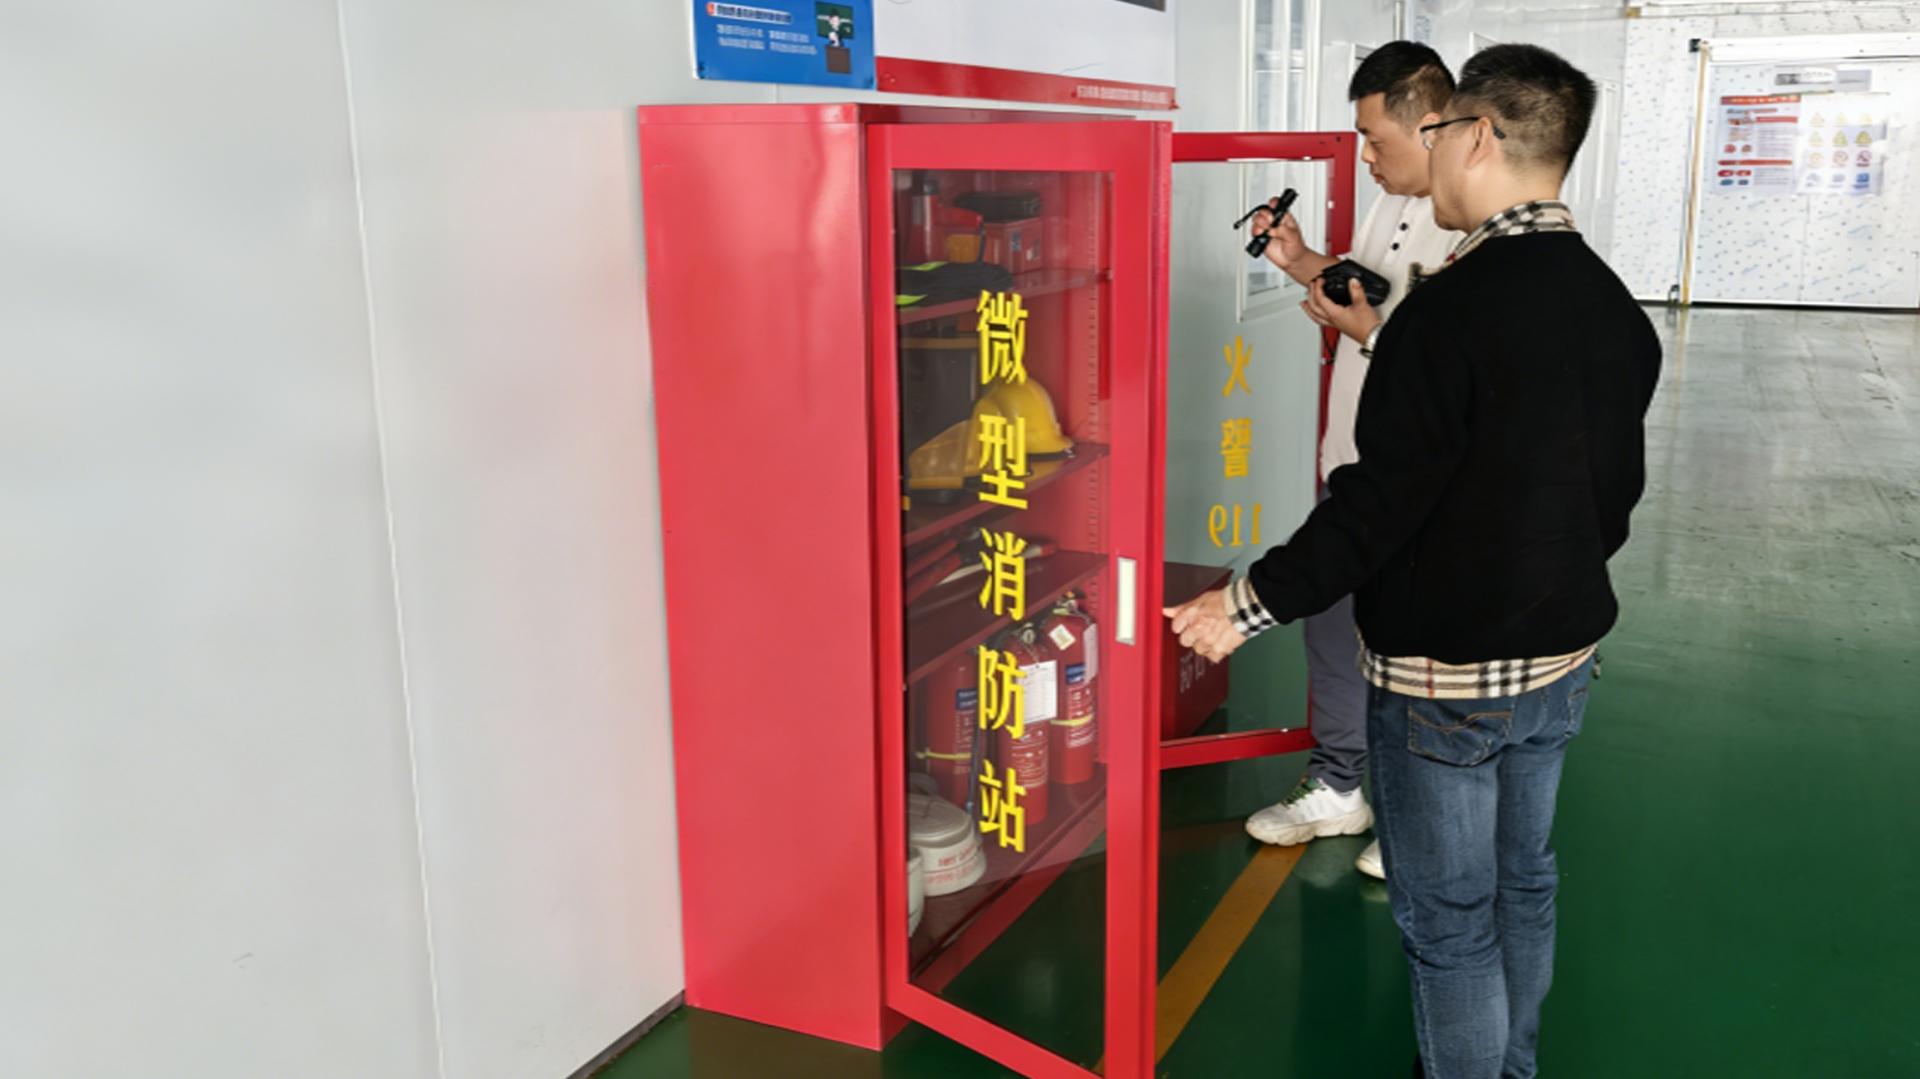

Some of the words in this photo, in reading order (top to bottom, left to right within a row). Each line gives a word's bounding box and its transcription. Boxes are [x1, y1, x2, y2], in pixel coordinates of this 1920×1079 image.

[976, 289, 1029, 853] 微型消防站
